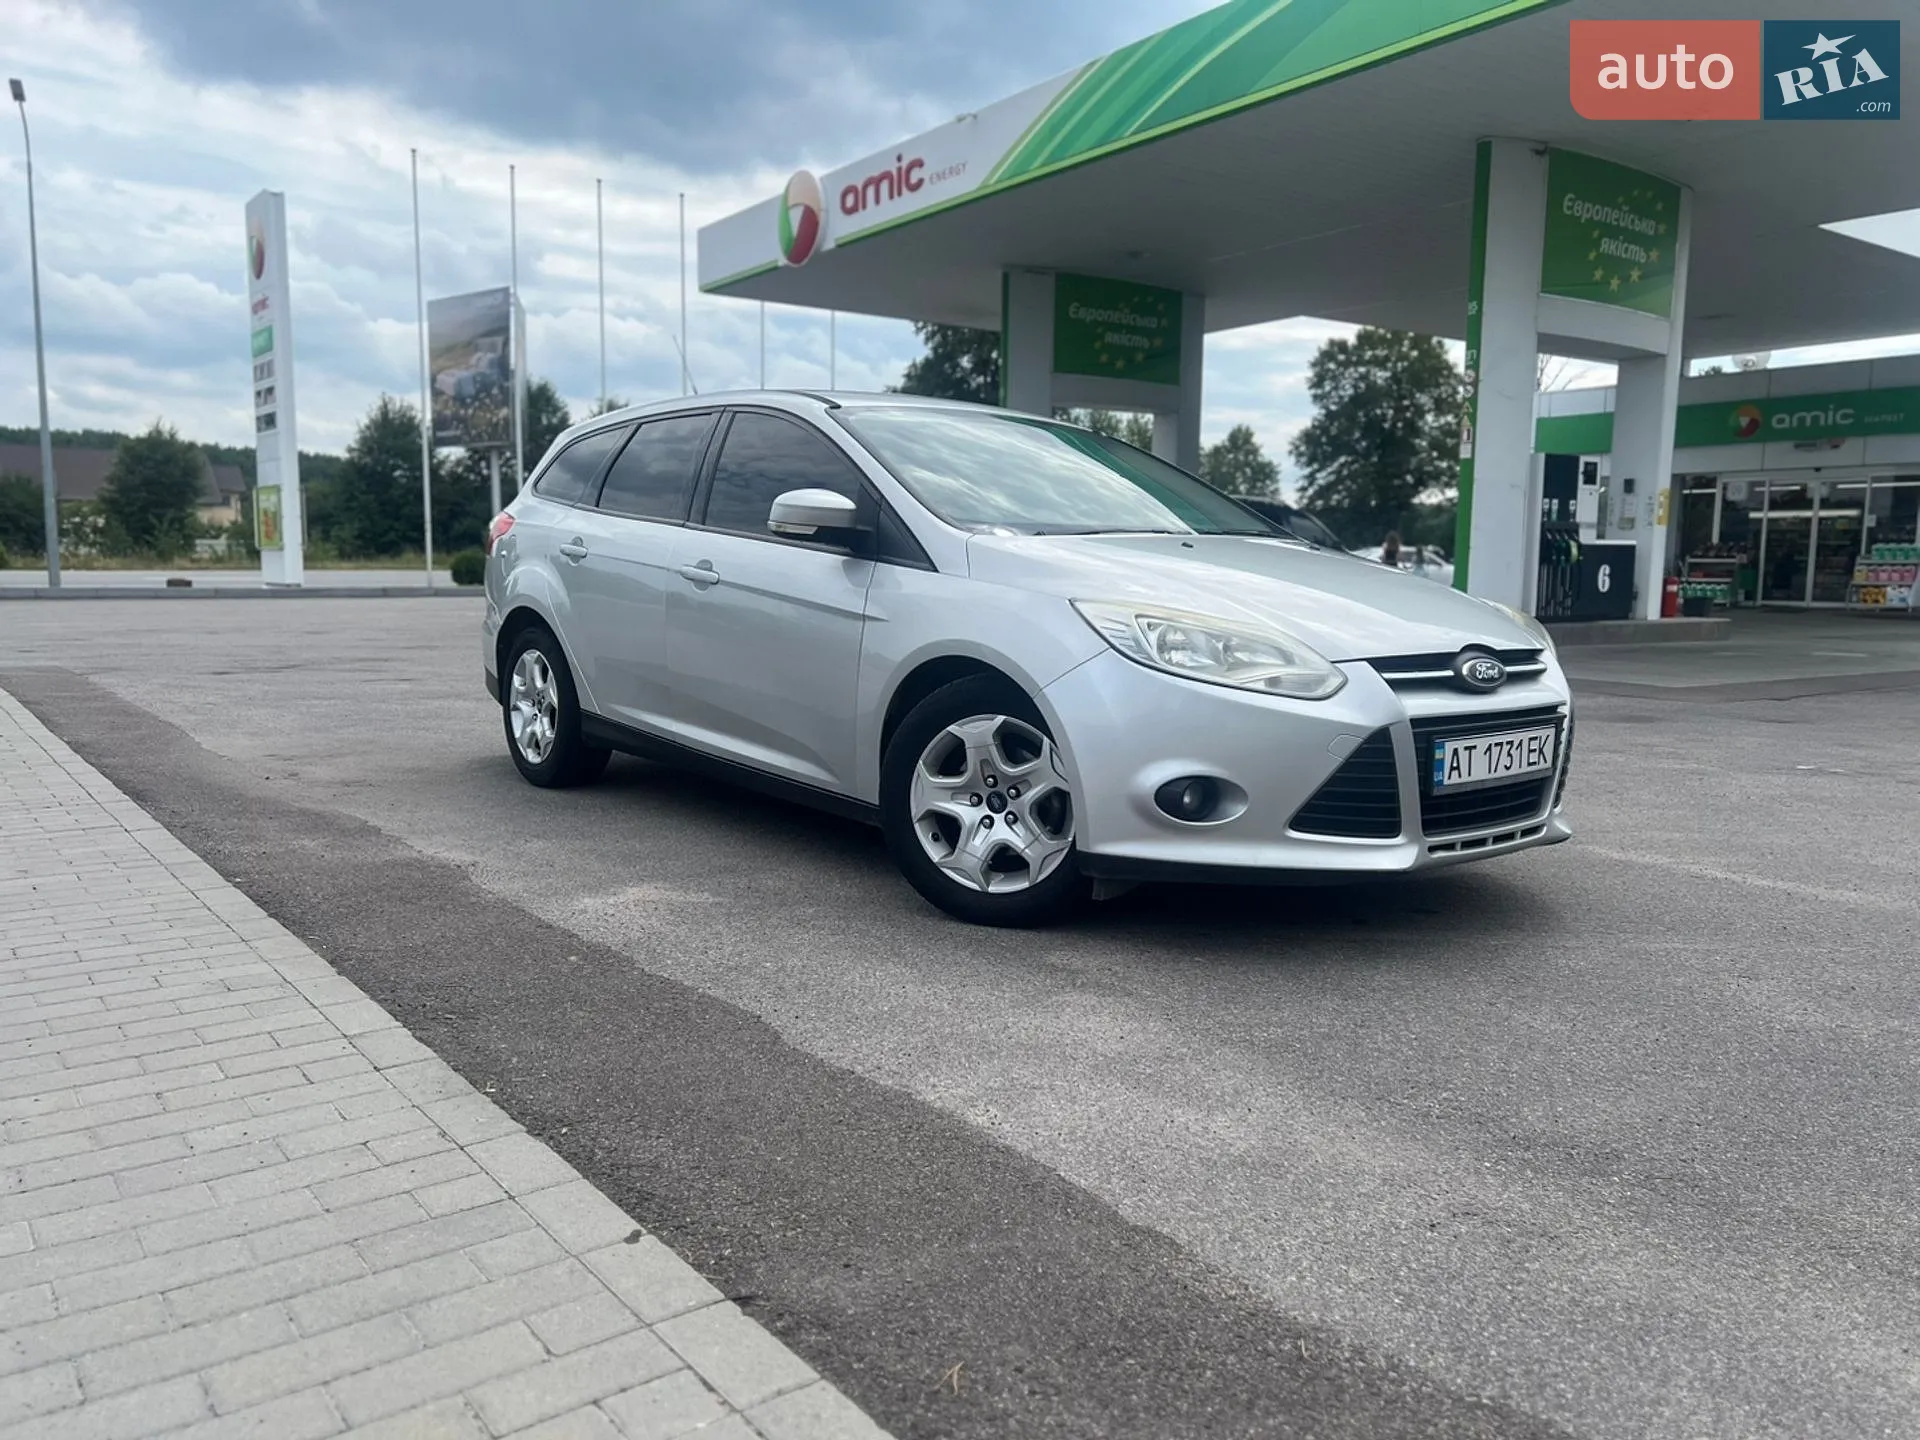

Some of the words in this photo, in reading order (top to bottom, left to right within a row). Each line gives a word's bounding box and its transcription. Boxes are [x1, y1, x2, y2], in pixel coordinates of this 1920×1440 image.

[839, 152, 925, 216] amic
[928, 161, 968, 186] ENERGY
[1562, 193, 1656, 236] Європейська
[1599, 235, 1647, 263] якість
[1771, 404, 1856, 429] amic
[1597, 564, 1611, 593] 6
[1474, 662, 1501, 680] Ford
[1447, 742, 1477, 781] AT
[1483, 738, 1523, 775] 1731
[1527, 733, 1551, 767] EK
